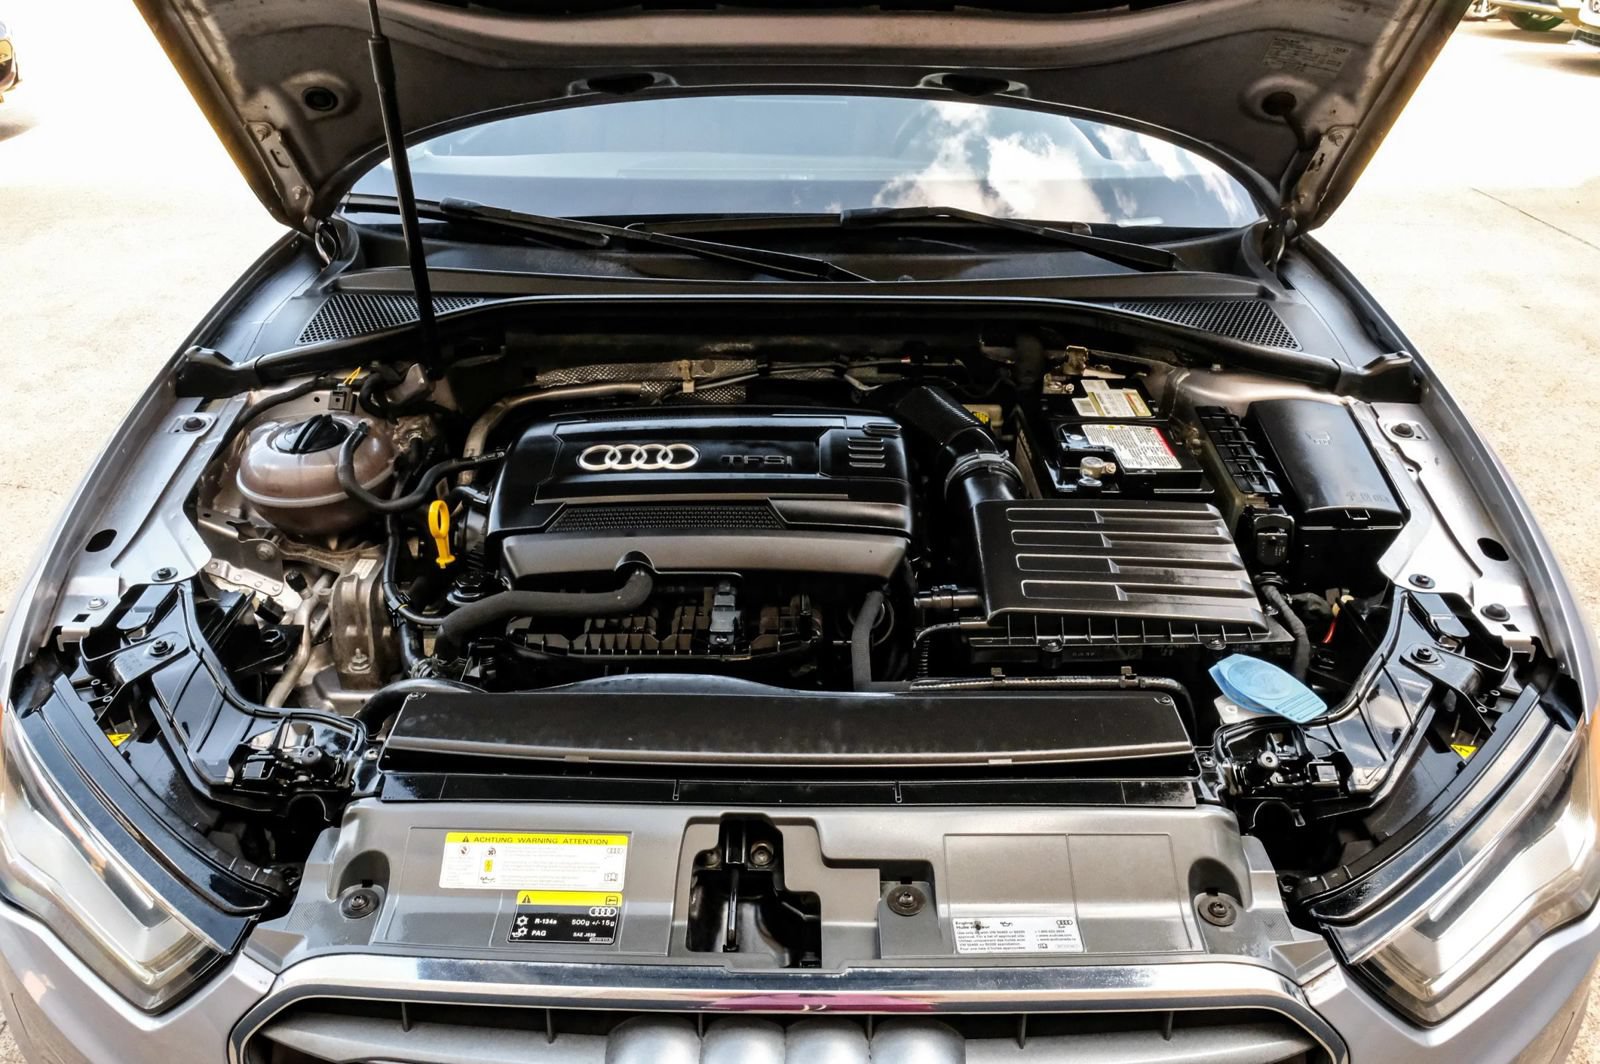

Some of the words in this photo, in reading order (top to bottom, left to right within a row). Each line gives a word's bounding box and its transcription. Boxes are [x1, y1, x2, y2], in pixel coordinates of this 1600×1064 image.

[721, 454, 793, 466] TFSI
[518, 837, 559, 845] WARNING
[531, 929, 547, 937] PAG
